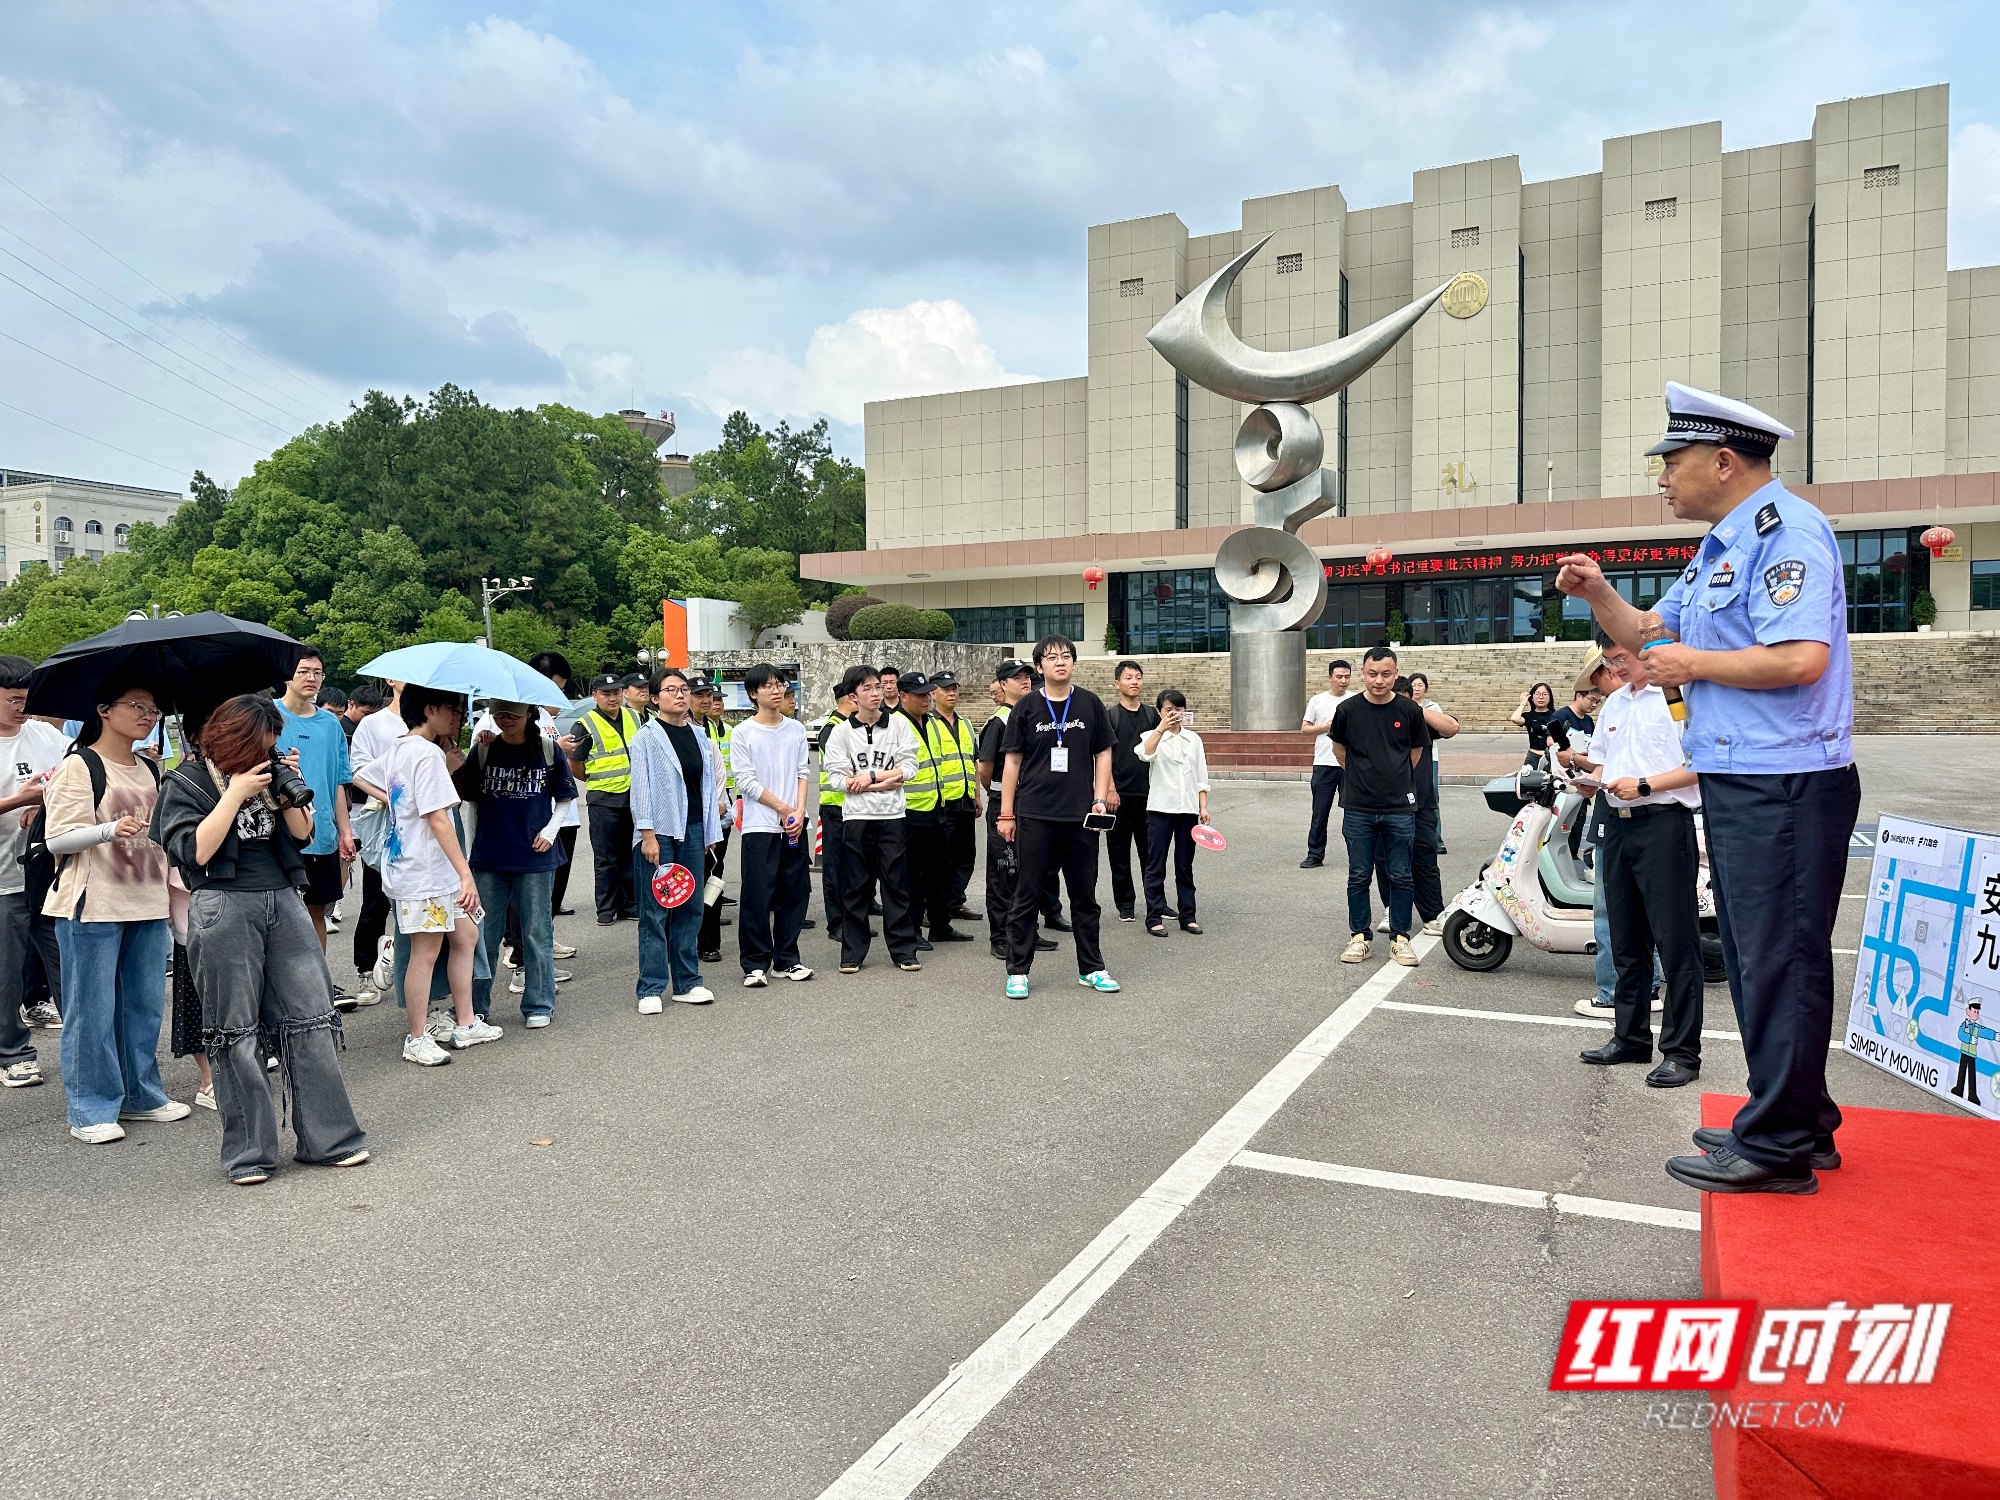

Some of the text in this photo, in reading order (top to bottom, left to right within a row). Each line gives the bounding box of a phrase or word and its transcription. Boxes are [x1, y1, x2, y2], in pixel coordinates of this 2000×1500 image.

[1441, 462, 1475, 495] 礼
[1510, 545, 1702, 569] 努力把办得更好更有特
[1972, 923, 2000, 971] 九
[1849, 1032, 1939, 1088] SIMPLY MOVING
